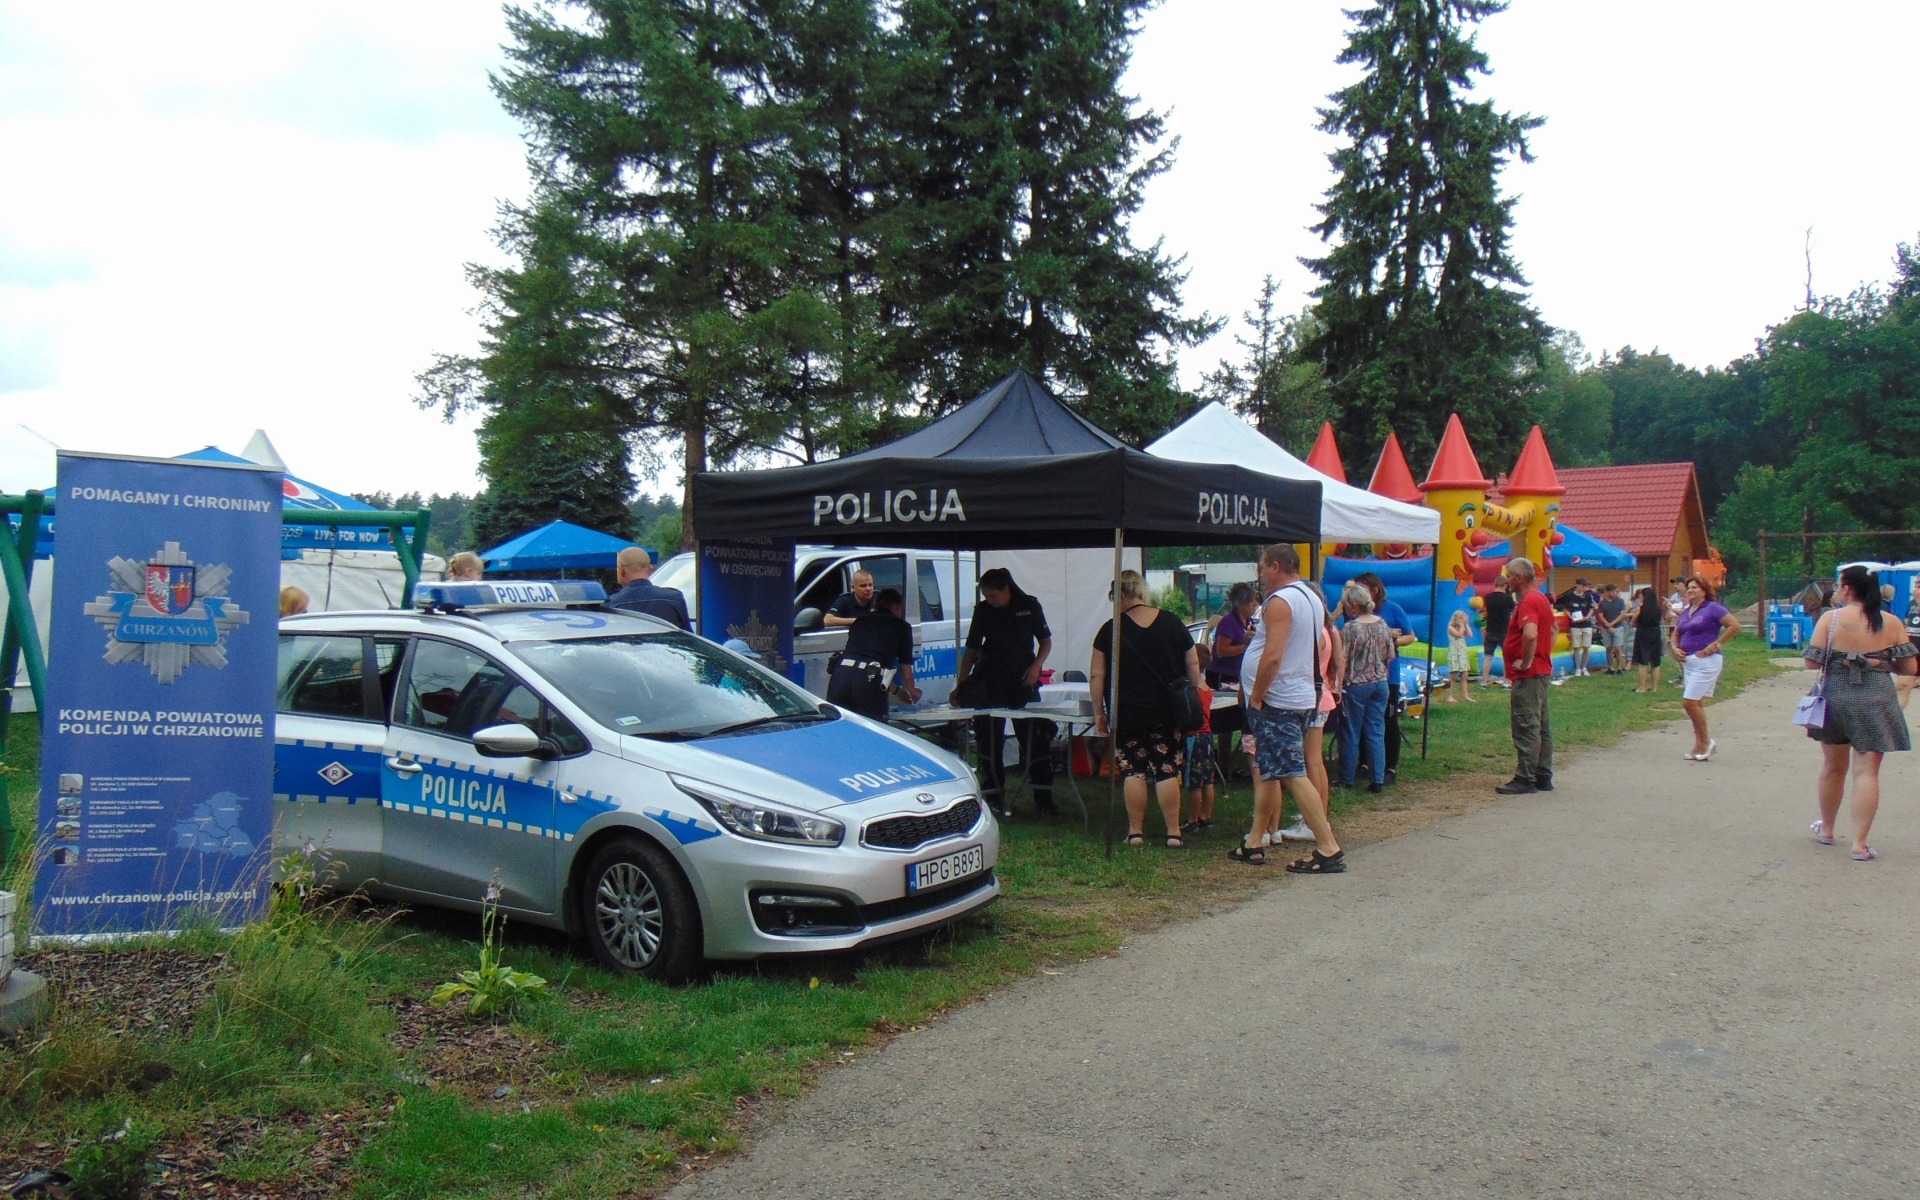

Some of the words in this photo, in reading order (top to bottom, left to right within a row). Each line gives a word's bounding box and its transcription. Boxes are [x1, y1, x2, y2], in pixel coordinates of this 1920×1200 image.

[71, 486, 169, 505] POMAGAMY
[174, 494, 180, 506] I
[183, 495, 271, 513] CHRONIMY
[812, 488, 966, 526] POLICJA
[1197, 491, 1269, 528] POLICJA
[281, 526, 303, 540] epsi
[339, 530, 356, 541] FOR
[359, 532, 380, 543] NOW
[705, 546, 760, 560] POWIATOWA
[720, 563, 729, 574] W
[1580, 557, 1602, 566] pepsi
[496, 585, 557, 603] POLICJA
[122, 622, 210, 638] CHRZANÓW
[59, 709, 151, 722] KOMENDA
[156, 711, 264, 725] POWIATOWA
[59, 723, 128, 735] POLICJI
[132, 724, 148, 735] W
[152, 724, 264, 738] CHRZANOWIE
[331, 769, 339, 777] R
[839, 764, 936, 792] POLICJA
[421, 774, 507, 815] POLICJA
[918, 859, 950, 887] HPG
[953, 849, 980, 877] B893
[51, 889, 256, 905] www.chrzanow.policja.gov.pl
